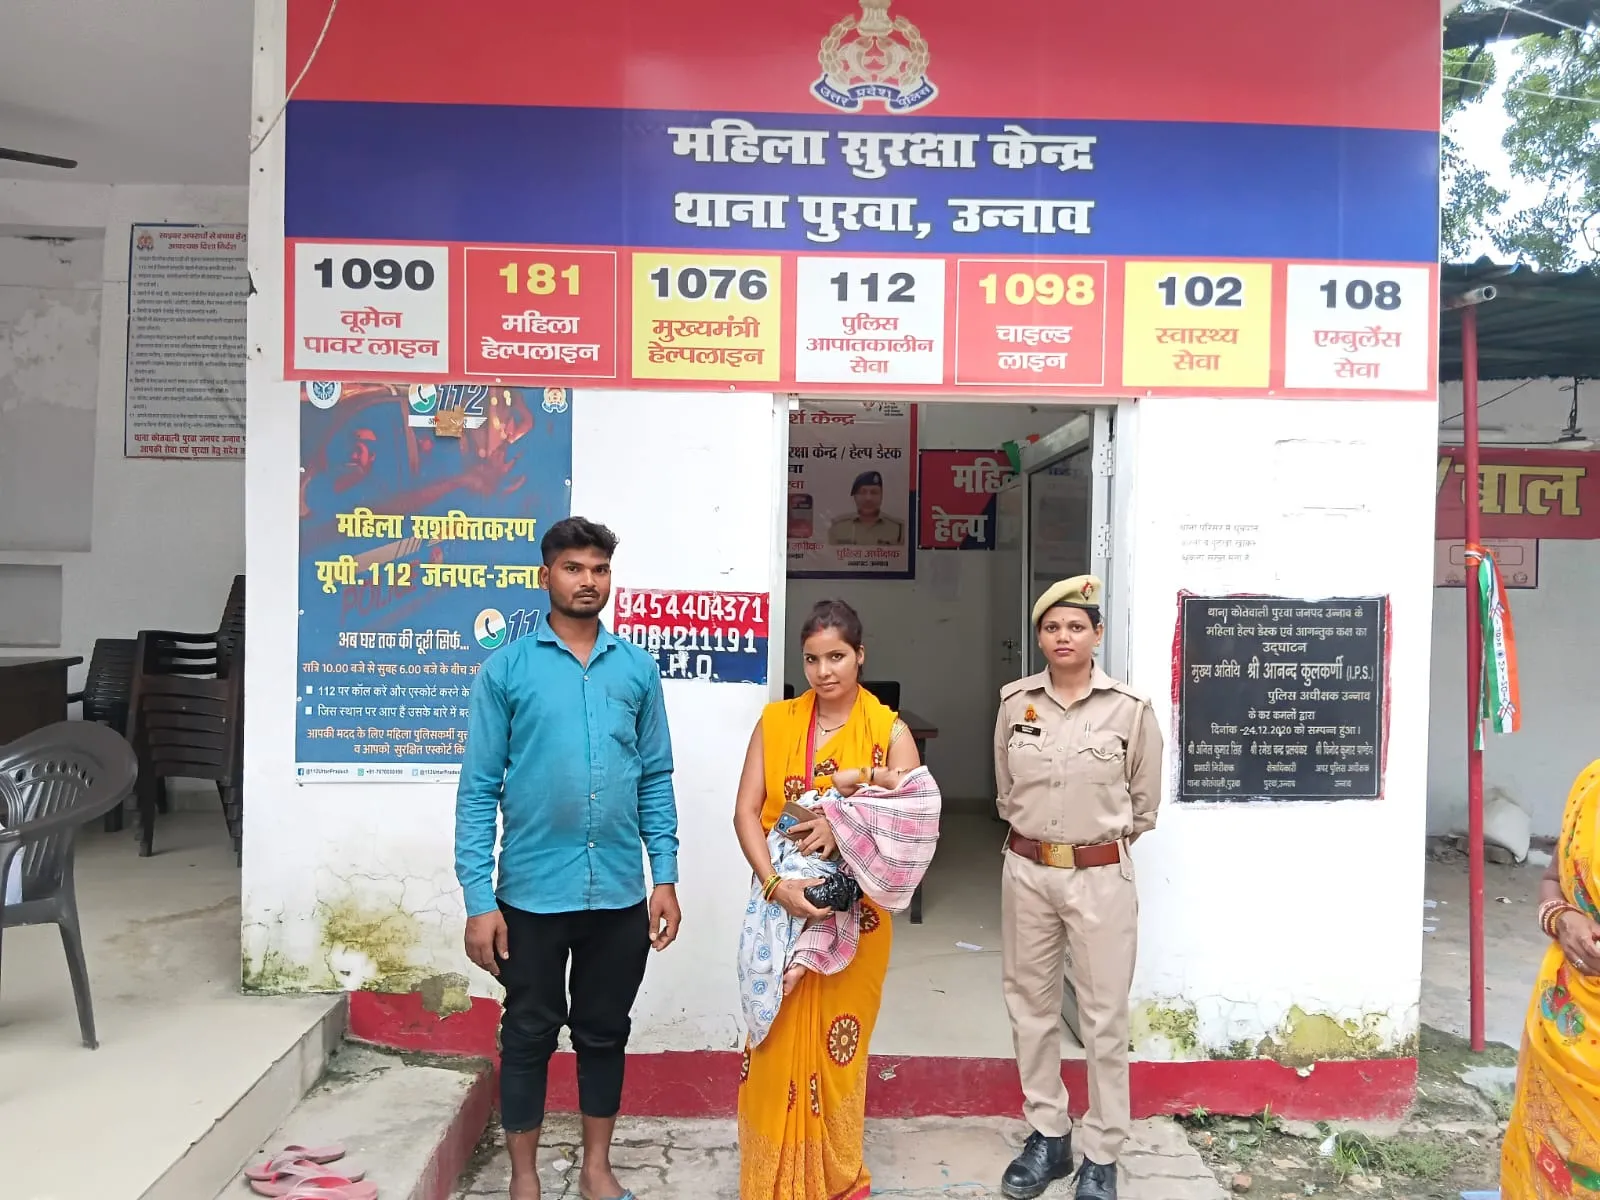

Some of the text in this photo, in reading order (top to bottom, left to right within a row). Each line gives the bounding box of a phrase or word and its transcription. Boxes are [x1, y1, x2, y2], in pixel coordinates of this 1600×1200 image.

[667, 119, 1097, 178] महिला सुरक्षा केन्द्र
[674, 193, 1095, 242] थाना पुरवा, उन्नाव
[313, 257, 435, 290] 1090
[499, 262, 581, 295] 181
[650, 267, 767, 300] 1076
[830, 272, 916, 303] 112
[978, 273, 1096, 305] 1098
[1158, 275, 1243, 307] 102
[1320, 279, 1402, 310] 108
[341, 305, 402, 328] वूमेन
[502, 310, 579, 333] महिला
[841, 314, 898, 336] पुलिस
[652, 316, 760, 342] मुख्यमंत्री
[996, 324, 1072, 347] चाइल्ड
[1156, 326, 1238, 347] स्वास्थ्य
[303, 336, 439, 357] पावर लाइन
[482, 336, 599, 363] हेल्पलाइन
[648, 341, 764, 366] हेल्पलाइन
[806, 335, 934, 355] आपातकालीन
[849, 355, 889, 374] सेवा
[998, 352, 1067, 371] लाइन
[1173, 349, 1220, 371] सेवा
[1334, 357, 1380, 379] सेवा
[438, 384, 488, 415] 112
[811, 410, 856, 425] केन्द्र
[812, 442, 902, 459] केन्द्र हेल्प डेस्क
[336, 507, 537, 541] महिला सशक्तिकरण
[931, 506, 988, 543] हेल्प
[420, 564, 540, 589] जनपद-उन्ना
[618, 590, 763, 623] 9454404371
[1208, 607, 1228, 618] थाना
[1272, 608, 1292, 621] पुरवा
[1295, 609, 1323, 618] जनपद
[1325, 609, 1351, 618] उन्नाव
[1354, 606, 1363, 618] के
[508, 609, 540, 646] 11
[618, 624, 757, 653] 8081211191
[1206, 623, 1234, 636] महिला
[1237, 624, 1255, 636] हेल्प
[1257, 624, 1277, 636] डेस्क
[1280, 624, 1292, 636] एवं
[1295, 626, 1333, 640] आगन्तुक
[1355, 627, 1367, 636] का
[339, 631, 357, 648] अब
[360, 631, 375, 648] घर
[378, 632, 395, 648] तक
[398, 628, 413, 649] की
[415, 628, 432, 654] दूरी
[302, 660, 320, 673] रात्रि
[322, 664, 348, 673] 10.00
[367, 661, 375, 673] से
[377, 664, 397, 677] सुबह
[399, 664, 421, 674] 6.00
[440, 661, 449, 674] के
[451, 661, 467, 675] बीच
[1191, 663, 1212, 682] मुख्य
[1215, 659, 1240, 678] अतिथि
[1247, 655, 1260, 680] श्री
[1263, 663, 1297, 680] आनन्द
[1300, 655, 1344, 686] कुलकर्णी
[318, 682, 470, 698] 112 पर कॉल करें और एस्कोर्ट करने के
[1268, 689, 1370, 704] पुलिस अधीक्षक उन्नाव
[318, 703, 337, 717] जिस
[339, 706, 362, 717] स्थान
[365, 707, 377, 717] पर
[379, 706, 396, 717] आप
[408, 704, 431, 717] उसके
[433, 704, 448, 717] बारे
[1248, 708, 1255, 719] के
[1258, 710, 1270, 720] कर
[1272, 707, 1297, 720] कमलों
[307, 727, 454, 743] आपकी मदद के लिए महिला पुलिसकर्मी
[1211, 722, 1237, 734] दिनांक
[1294, 723, 1305, 735] को
[362, 742, 389, 754] आपको
[394, 742, 423, 757] सुरक्षित
[425, 742, 452, 755] एस्कोर्ट
